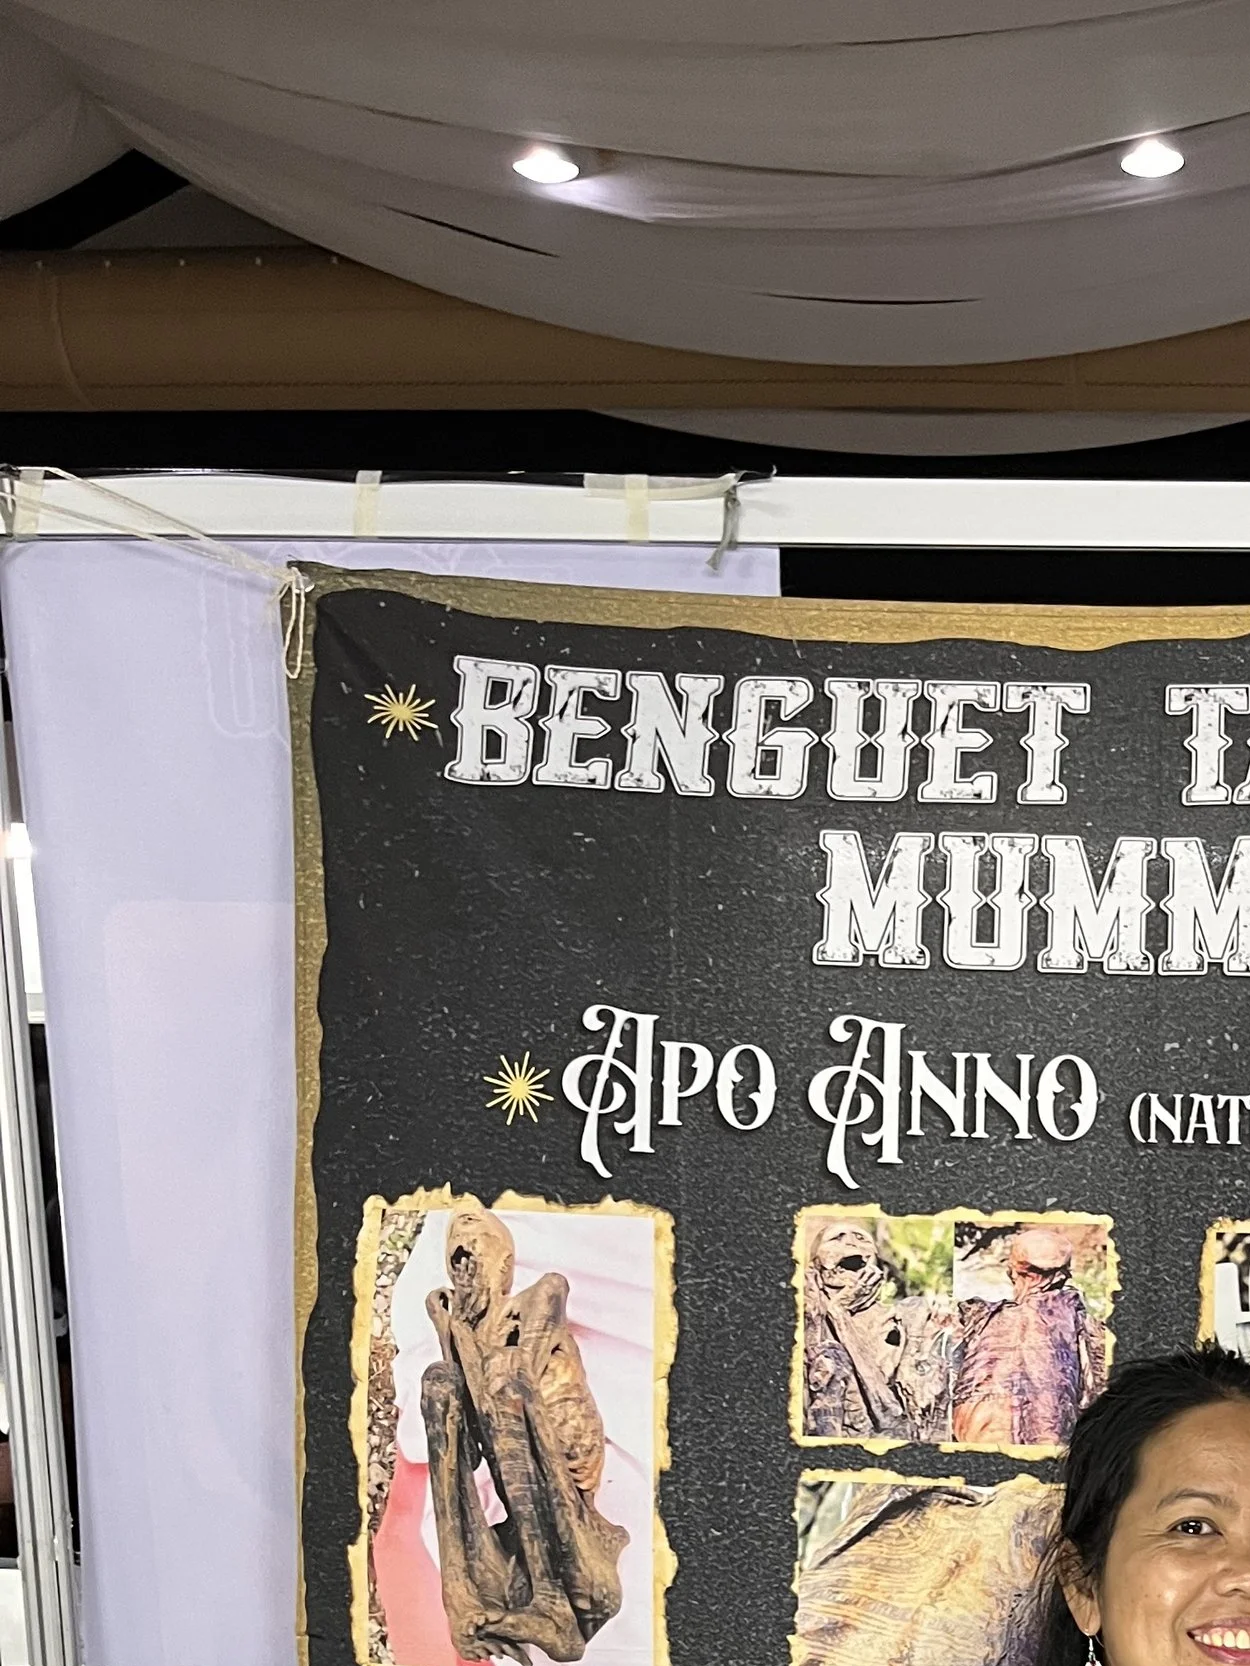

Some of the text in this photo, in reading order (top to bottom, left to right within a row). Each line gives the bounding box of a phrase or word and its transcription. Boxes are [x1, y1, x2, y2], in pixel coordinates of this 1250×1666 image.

[444, 654, 1092, 805] BENGUET
[561, 1004, 776, 1179] APO
[808, 1013, 1099, 1189] ANNO
